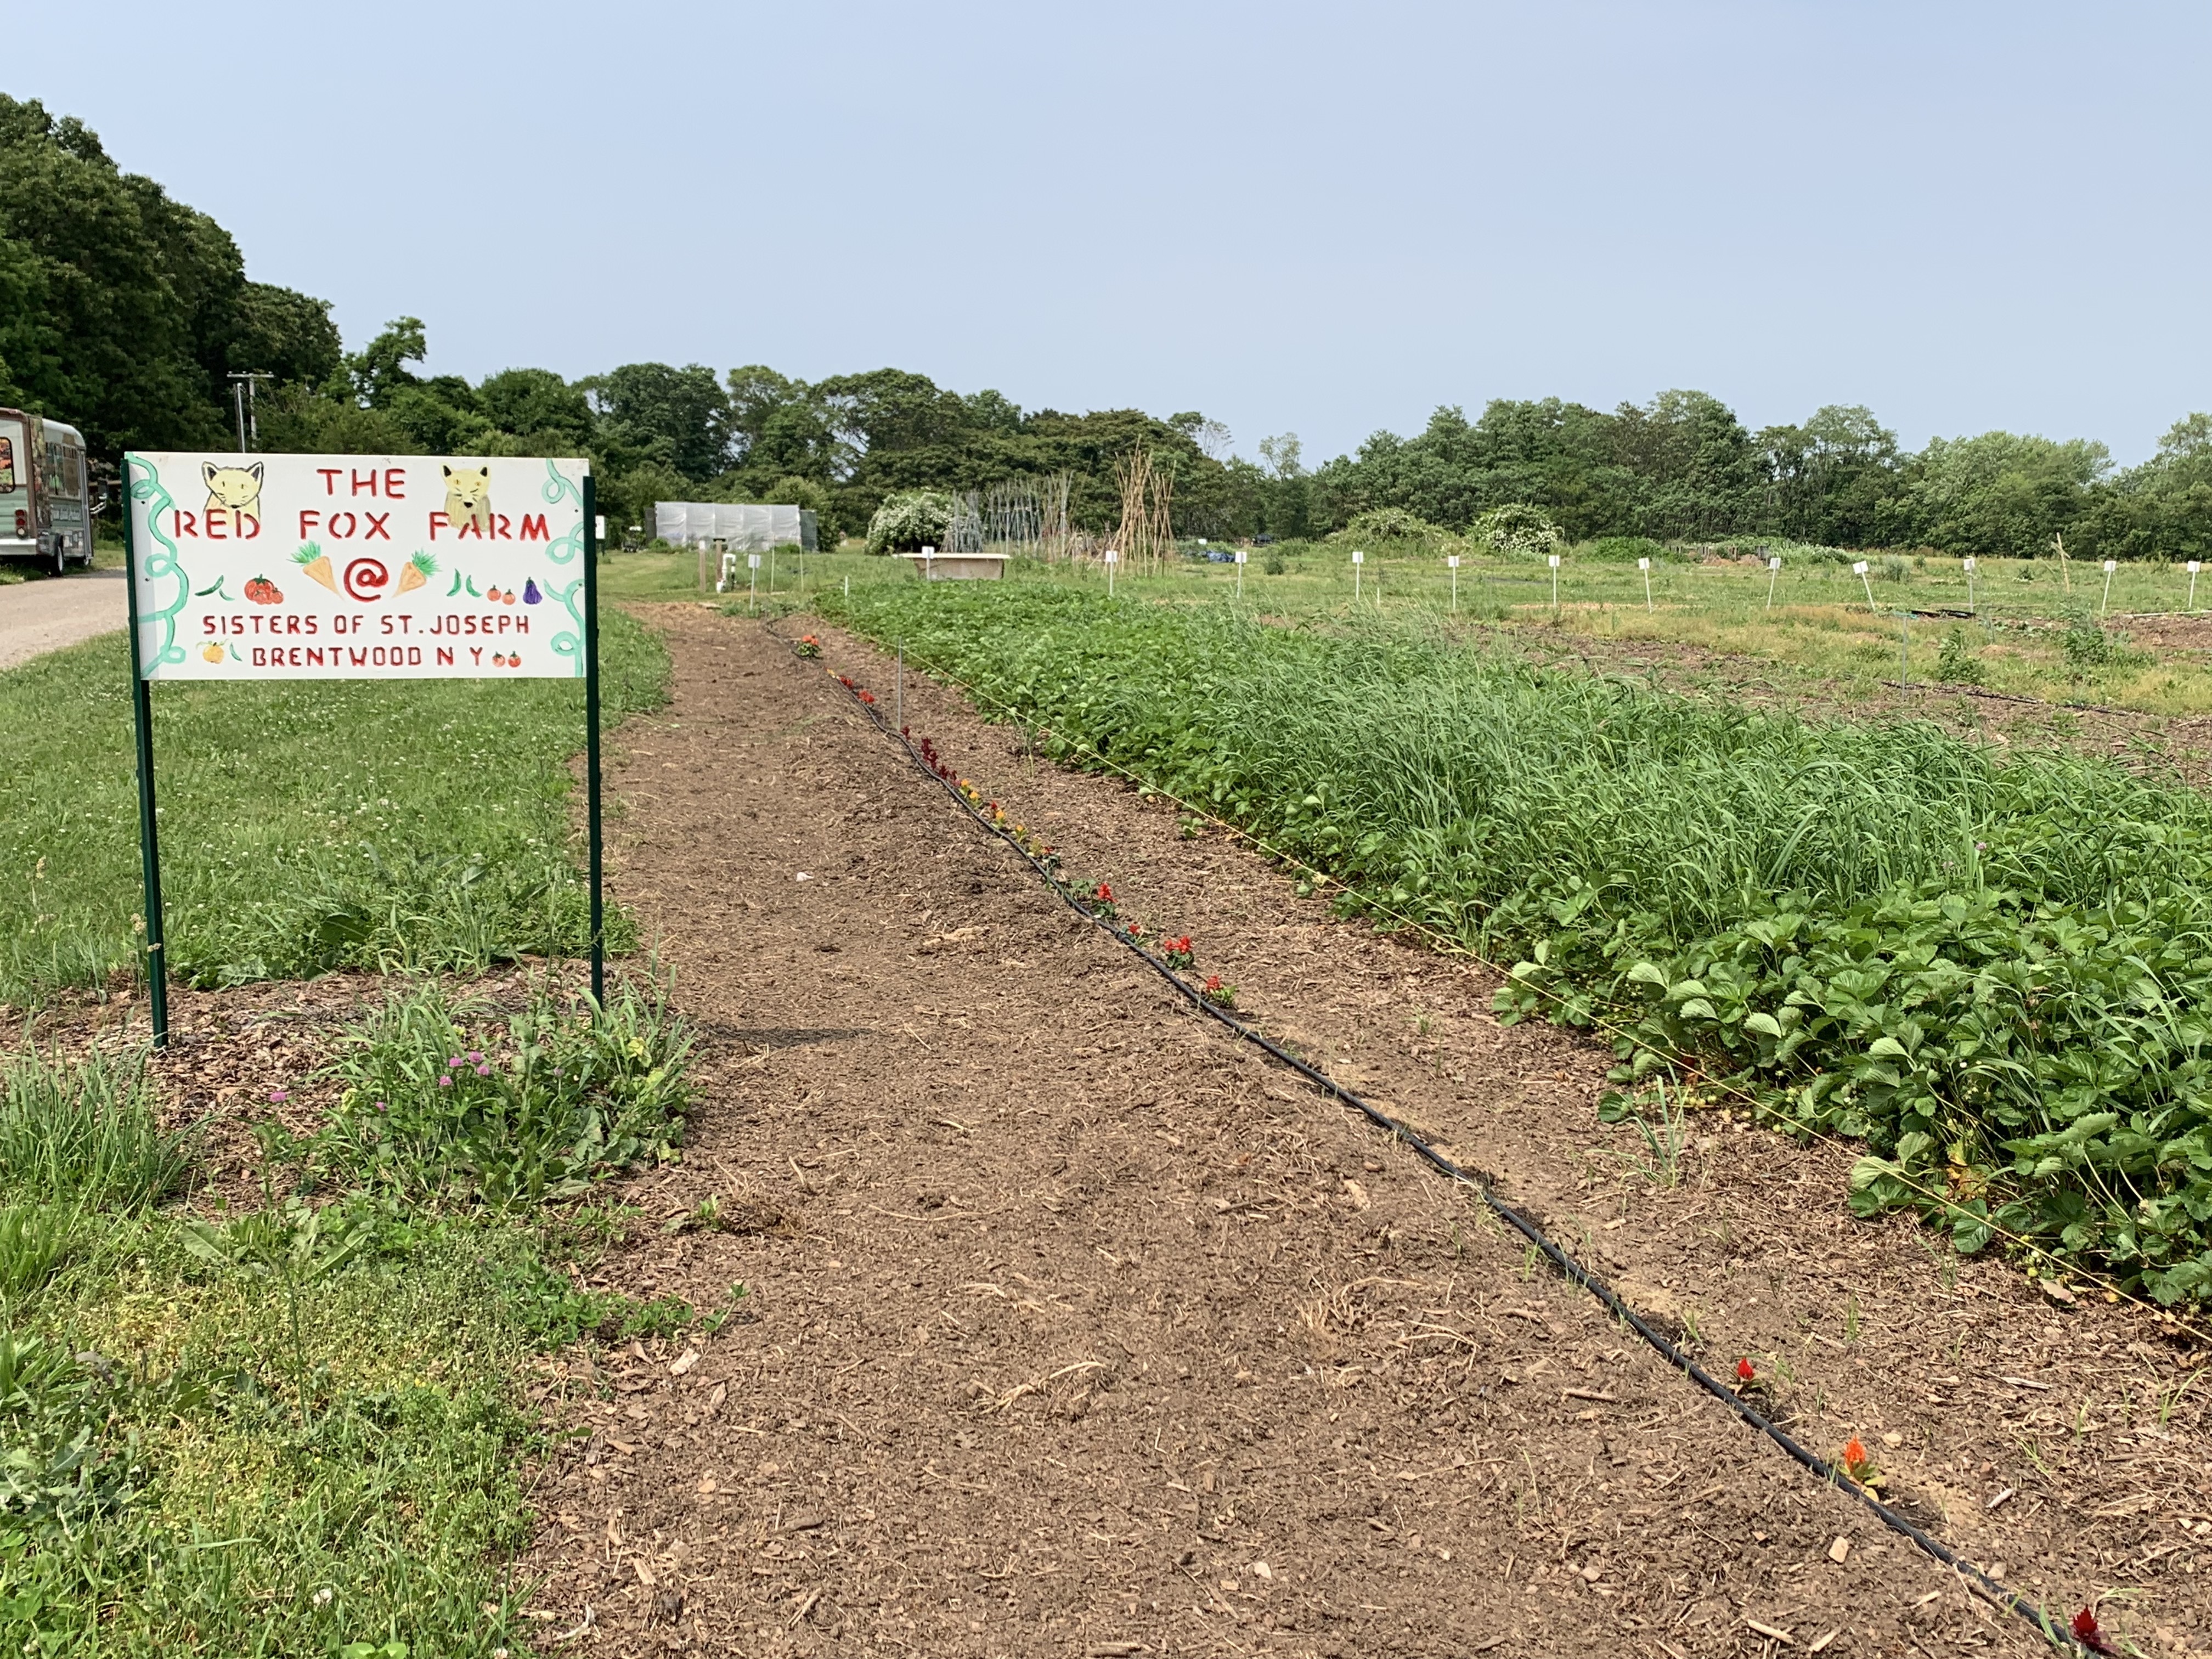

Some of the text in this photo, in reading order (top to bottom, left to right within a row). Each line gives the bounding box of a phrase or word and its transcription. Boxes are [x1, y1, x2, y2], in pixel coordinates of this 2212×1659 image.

[317, 469, 405, 499] THE
[175, 510, 550, 540] RED FOX FARM
[344, 558, 388, 602] @
[204, 616, 317, 634] SISTERS
[335, 616, 363, 634] OF
[253, 647, 421, 666] BRENTWOOD
